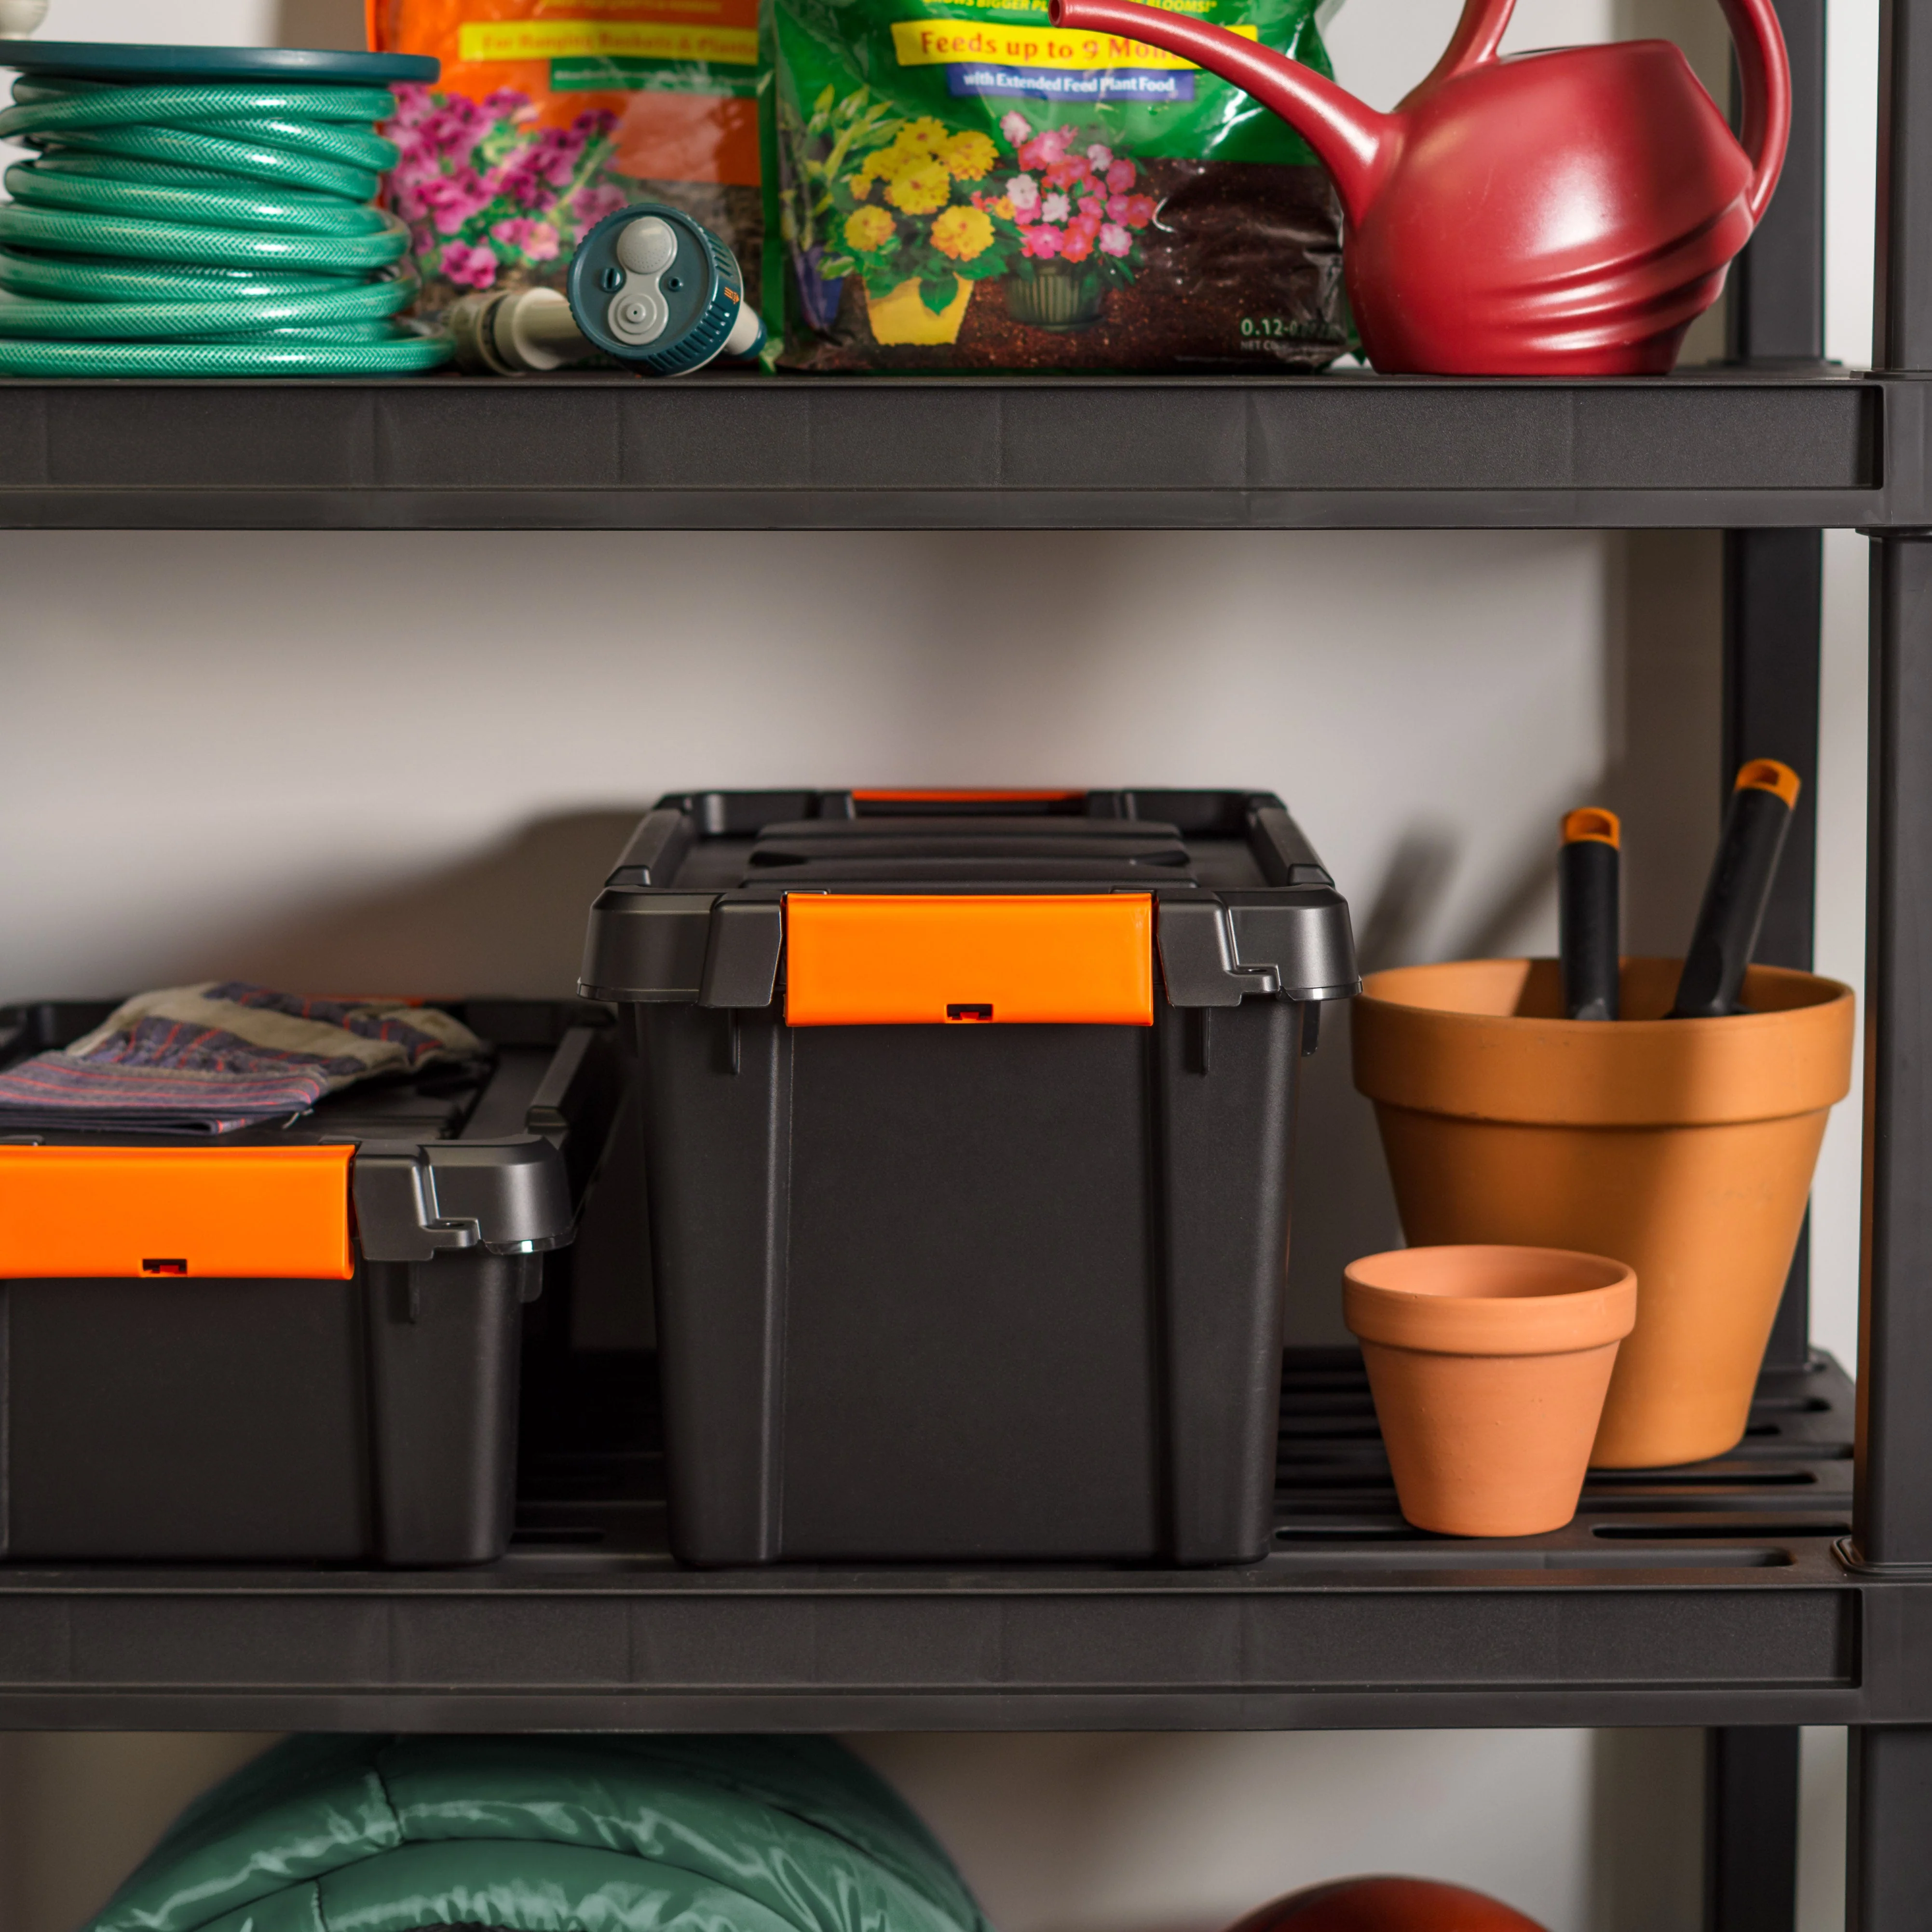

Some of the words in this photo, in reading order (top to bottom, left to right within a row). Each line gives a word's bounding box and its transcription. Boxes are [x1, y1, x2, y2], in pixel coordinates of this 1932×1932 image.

[921, 30, 997, 54] Feeds
[1007, 41, 1038, 61] up
[1048, 41, 1074, 59] to
[1083, 40, 1098, 60] 9
[1110, 38, 1178, 60] Mon
[964, 71, 993, 86] with
[996, 73, 1061, 91] Extended
[1063, 77, 1098, 92] Feed
[1100, 77, 1137, 91] Plant
[1139, 76, 1175, 91] Food
